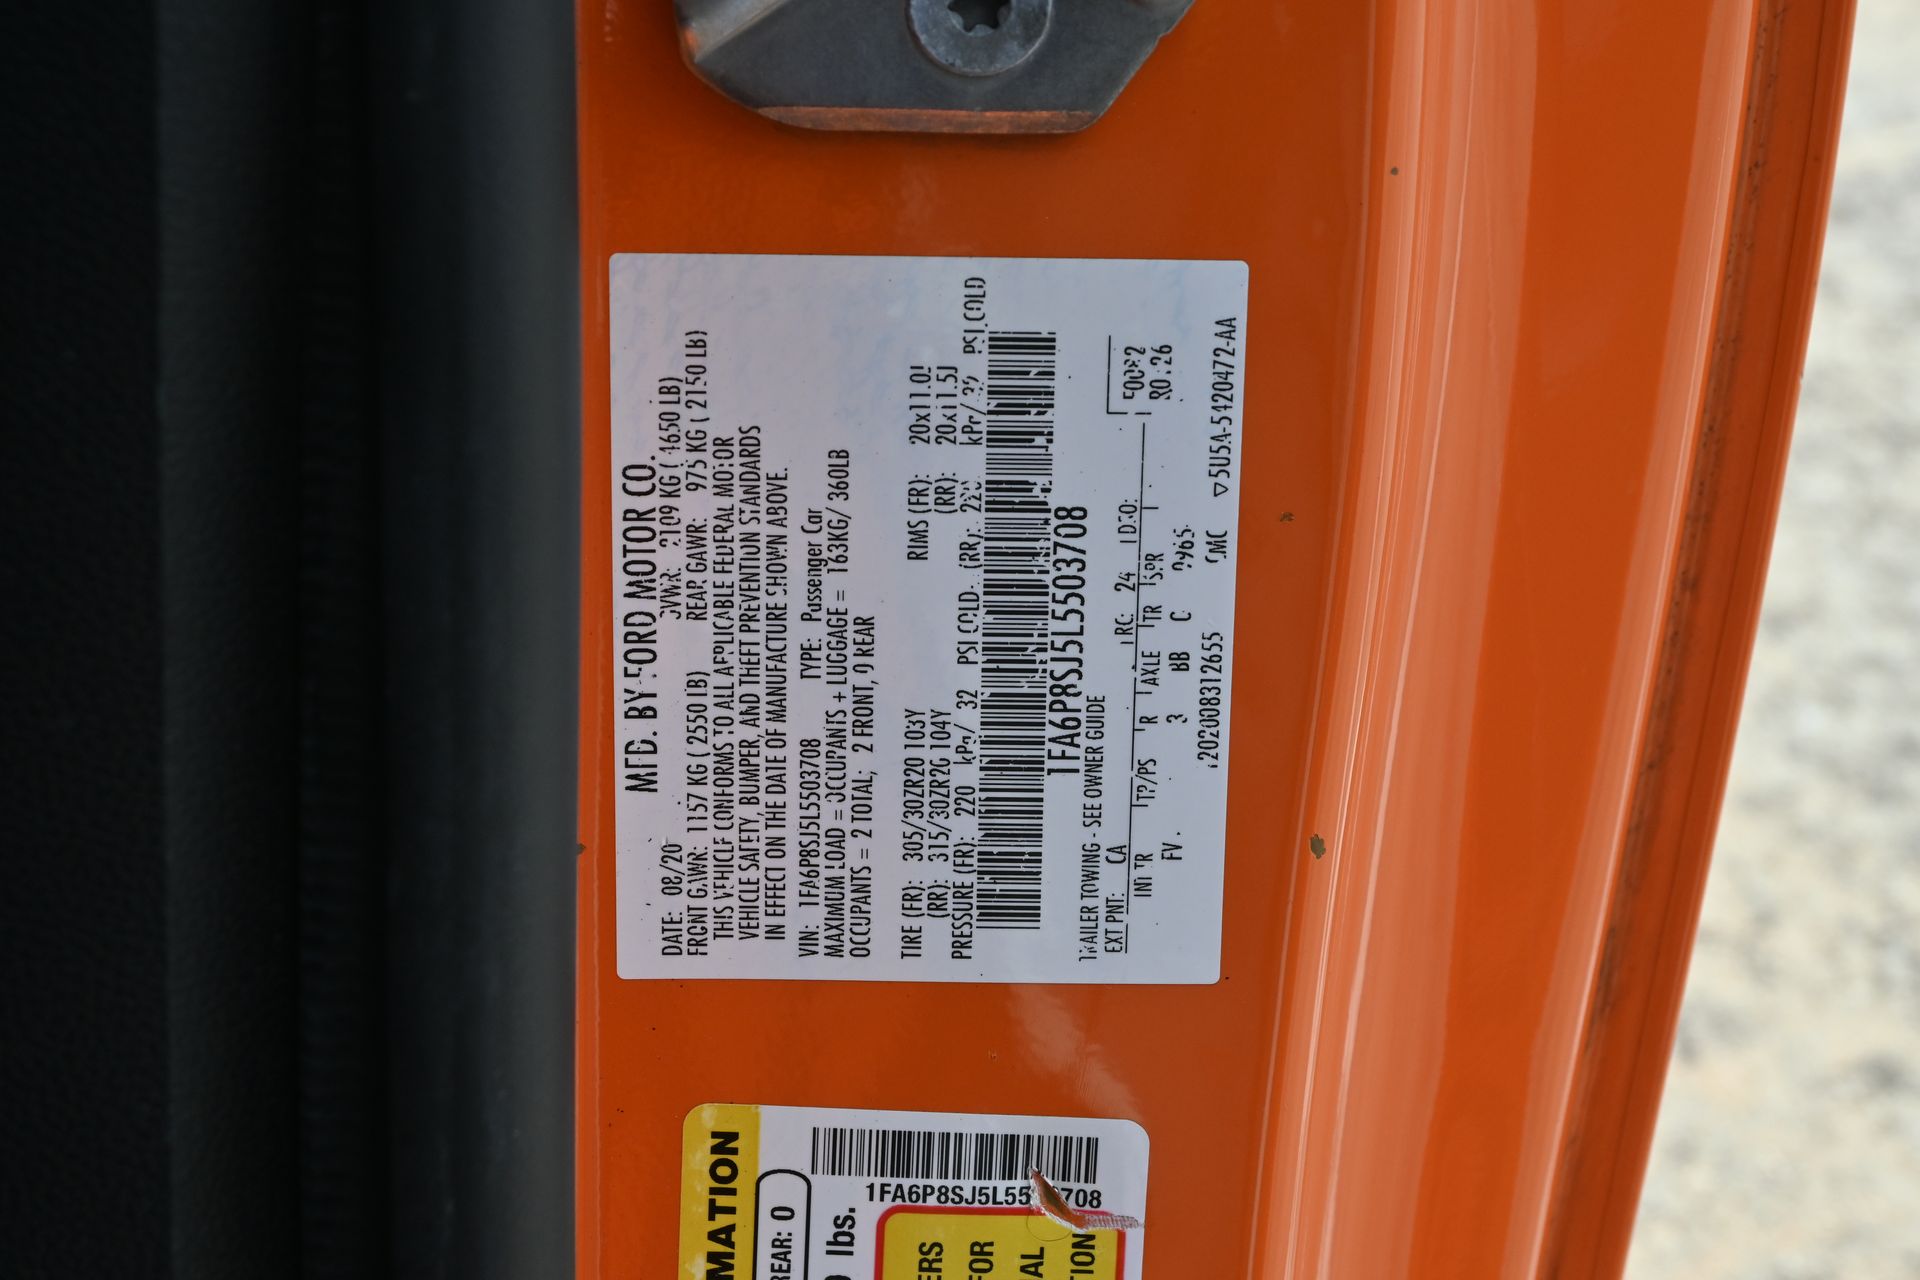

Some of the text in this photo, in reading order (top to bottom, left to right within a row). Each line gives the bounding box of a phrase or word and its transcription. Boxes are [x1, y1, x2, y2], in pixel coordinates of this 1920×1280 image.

[962, 276, 987, 322] COLD
[684, 330, 708, 358] LB)
[962, 329, 986, 355] PSI
[658, 376, 684, 405] LB)
[684, 364, 708, 410] 2150
[658, 411, 681, 455] 4650
[684, 429, 708, 453] KG
[933, 365, 960, 514] (RR): 20x11.5J
[684, 459, 708, 492] 975
[827, 449, 850, 502] 360LB
[906, 365, 933, 561] RIMS (FR): 20x11.0J
[658, 475, 682, 498] KG
[658, 504, 682, 548] 2109
[685, 518, 708, 573] GAWR:
[826, 506, 852, 575] 163KG/
[958, 528, 985, 569] (RR):
[1142, 552, 1165, 581] SPR
[685, 579, 708, 621] REAR
[799, 507, 830, 680] TYPE: Passenger Car
[957, 591, 980, 634] COLD
[1113, 571, 1137, 636] RC: 24
[1142, 604, 1163, 623] TR
[621, 455, 659, 793] MFD. BY FORD MOTOR CO.
[852, 615, 875, 658] REAR
[1169, 611, 1192, 622] C
[825, 607, 849, 685] LUGGAGE
[956, 640, 979, 665] PSI
[1046, 506, 1088, 776] 1FA6P8SJ5L5503708
[1168, 651, 1191, 672] BB
[685, 670, 711, 697] LB)
[711, 436, 735, 941] THIS VEHICLE CONFORMS TO ALL APPLICABLE FEDERAL MOTOR
[737, 425, 766, 941] VEHICLE SAFETY, BUMPER, AND THEFT PREVENTION STANDARDS
[1140, 650, 1161, 687] AXLE
[763, 467, 788, 940] IN EFFECT ON THE DATE OF MANUFACTURE SHOWN ABOVE.
[851, 680, 879, 737] FRONT,
[955, 689, 978, 710] 32
[1084, 695, 1106, 741] GUIDE
[1138, 715, 1159, 725] R
[1165, 713, 1188, 724] 3
[685, 703, 708, 745] 2550
[824, 709, 848, 803] OCCUPANTS
[851, 743, 874, 753] 2
[686, 763, 709, 786] KG
[1083, 745, 1104, 799] OWNER
[1134, 758, 1158, 802] TP/PS
[686, 792, 709, 833] 1157
[850, 770, 879, 824] TOTAL;
[926, 708, 953, 919] (RR): 315/30ZR20 104Y
[953, 785, 976, 817] 220
[1082, 802, 1103, 828] SEE
[798, 738, 822, 958] VIN: 1FA6P8SJ5L5503708
[823, 827, 846, 870] LOAD
[850, 828, 873, 839] 2
[900, 708, 928, 960] TIRE (FR): 305/30ZR20 103Y
[1160, 842, 1183, 861] FV
[686, 846, 709, 899] GAWR:
[952, 836, 979, 876] (FR):
[1080, 842, 1101, 901] TOWING
[1133, 853, 1154, 898] INT TR
[658, 843, 686, 956] DATE: 08/20
[823, 875, 846, 958] MAXIMUM
[848, 865, 872, 958] OCCUPANTS
[950, 881, 974, 960] PRESSURE
[1104, 844, 1128, 953] EXT PNT: CA
[686, 904, 709, 956] FRONT
[1078, 905, 1099, 962] TRAILER
[706, 1130, 740, 1280] MATION
[769, 1206, 796, 1221] 0
[865, 1182, 1102, 1208] 1FA6P8SJ5L55708
[825, 1207, 857, 1257] lbs.
